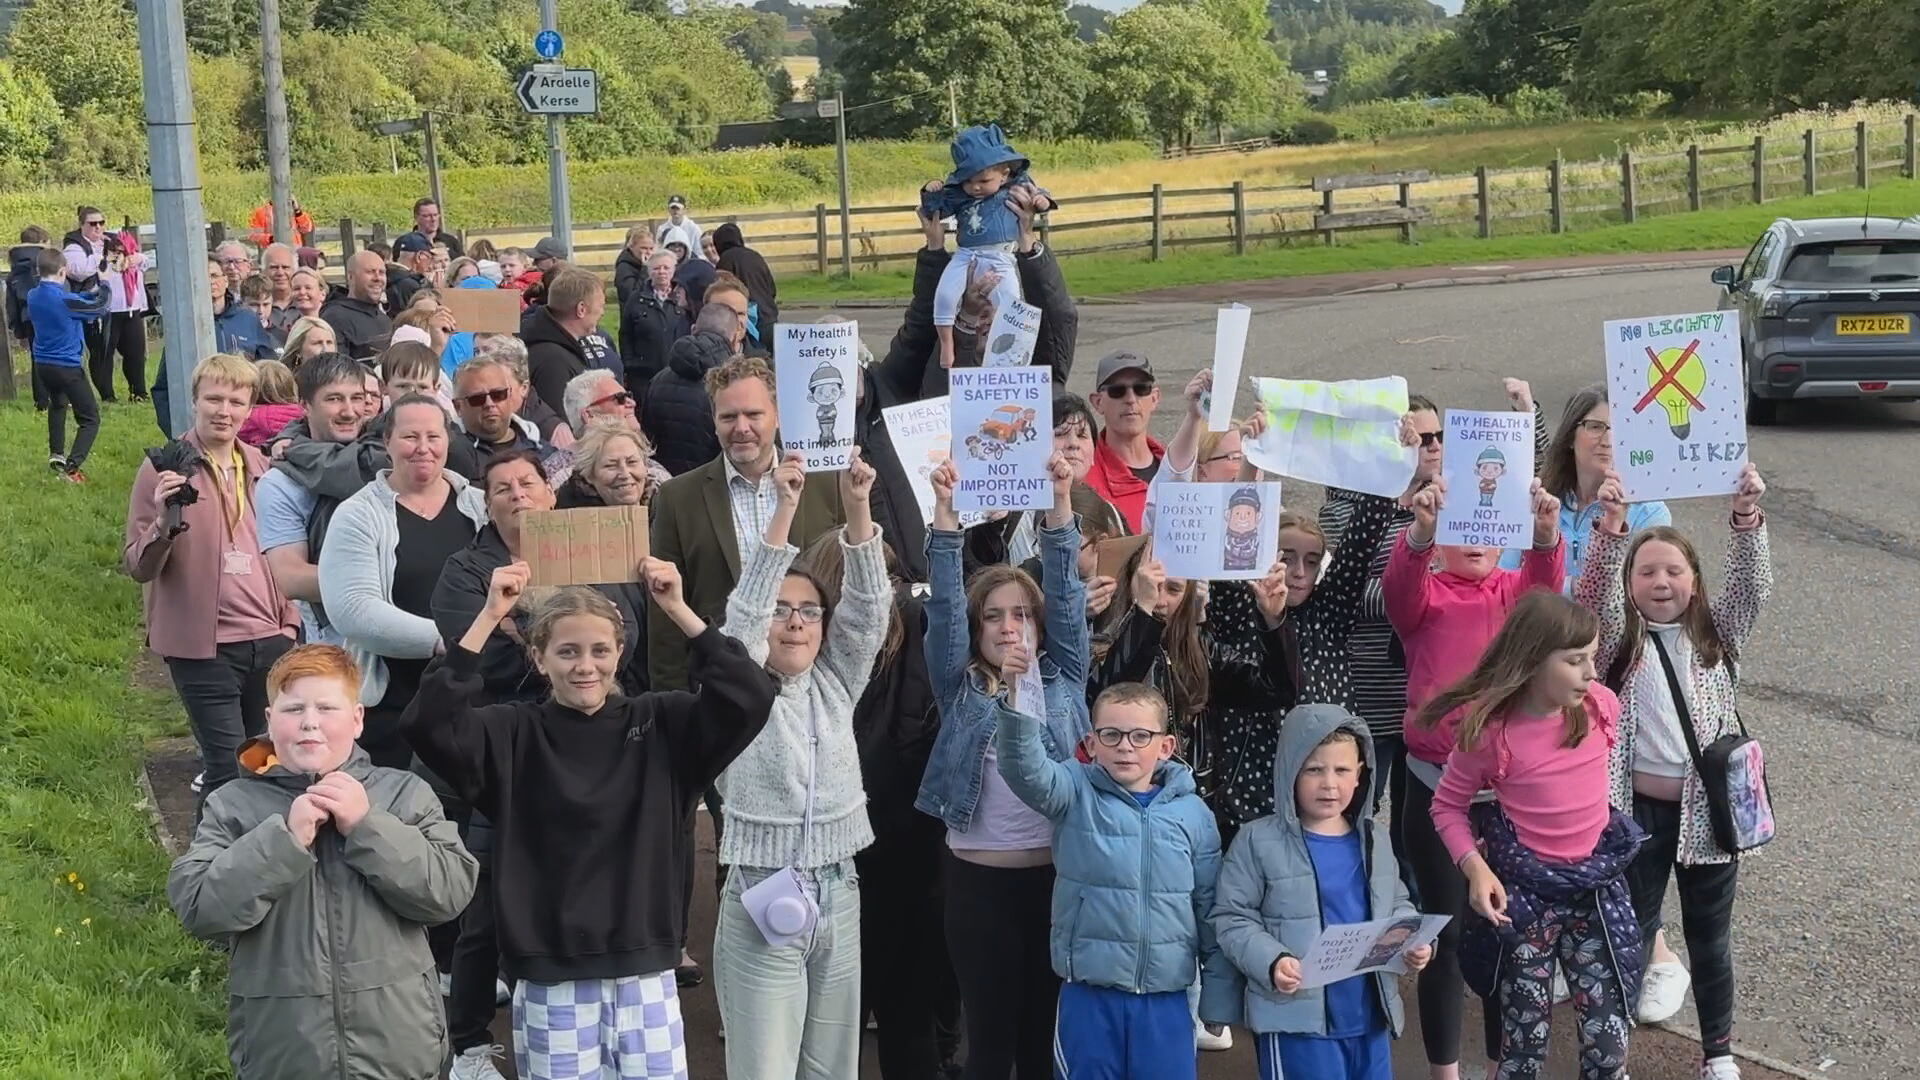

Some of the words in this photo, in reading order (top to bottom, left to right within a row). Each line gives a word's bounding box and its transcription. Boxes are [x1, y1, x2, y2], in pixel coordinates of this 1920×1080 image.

[540, 95, 579, 106] Kerse
[1010, 300, 1025, 315] My
[1648, 313, 1724, 337] LIGHTY
[1840, 319, 1875, 331] RX72
[1878, 318, 1905, 331] UZR
[788, 328, 806, 343] My
[810, 326, 847, 339] health
[798, 346, 837, 360] safety
[839, 345, 848, 356] is
[952, 374, 973, 386] MY
[977, 372, 1036, 385] HEALTH
[1040, 372, 1050, 384] &
[964, 388, 1021, 401] SAFETY
[1025, 387, 1040, 400] IS
[887, 412, 904, 425] MY
[908, 402, 951, 420] HEALT
[901, 417, 948, 437] SAFETY
[1451, 415, 1470, 426] MY
[1473, 416, 1521, 429] HEALTH
[1523, 418, 1530, 429] &
[1460, 430, 1509, 442] SAFETY
[1511, 431, 1522, 442] IS
[785, 439, 804, 450] not
[807, 437, 854, 451] importa
[807, 458, 820, 468] to
[822, 455, 845, 467] SLC
[987, 463, 1018, 476] NOT
[960, 478, 1047, 491] IMPORTANT
[976, 495, 996, 507] TO
[1001, 494, 1030, 506] SLC
[1178, 492, 1201, 502] SLC
[1162, 505, 1215, 516] DOESN'T
[1473, 509, 1501, 520] NOT
[1171, 518, 1205, 529] CARE
[1448, 520, 1523, 534] IMPORTANT
[1165, 532, 1208, 541] ABOUT
[1462, 534, 1479, 545] TO
[1483, 535, 1508, 547] SLC
[1175, 544, 1198, 554] ME!
